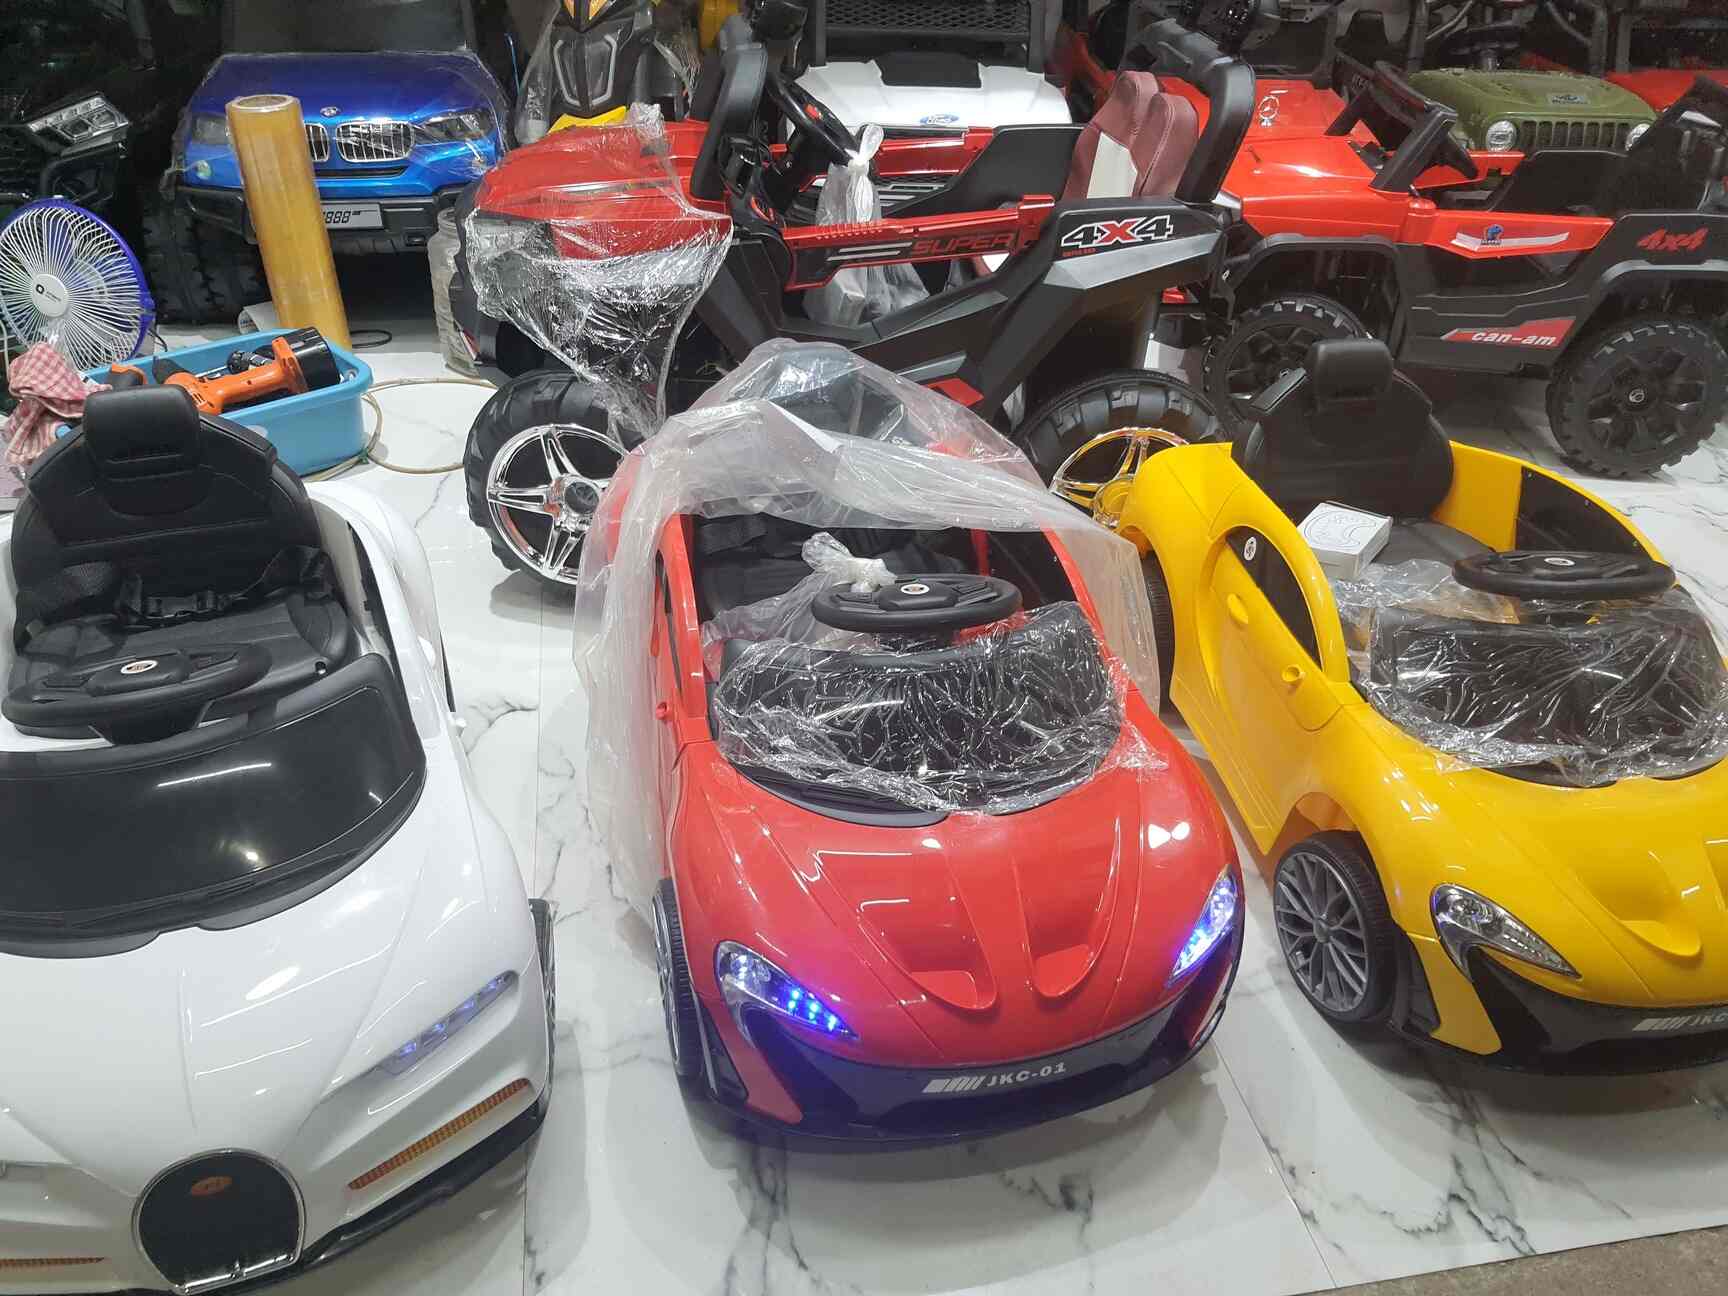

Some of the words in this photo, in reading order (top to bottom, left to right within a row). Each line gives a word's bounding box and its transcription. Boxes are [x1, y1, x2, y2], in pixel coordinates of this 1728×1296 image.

[322, 210, 351, 224] 888
[911, 231, 1014, 255] SUPER
[1471, 331, 1556, 346] can-am
[987, 1061, 1067, 1088] JKC-01
